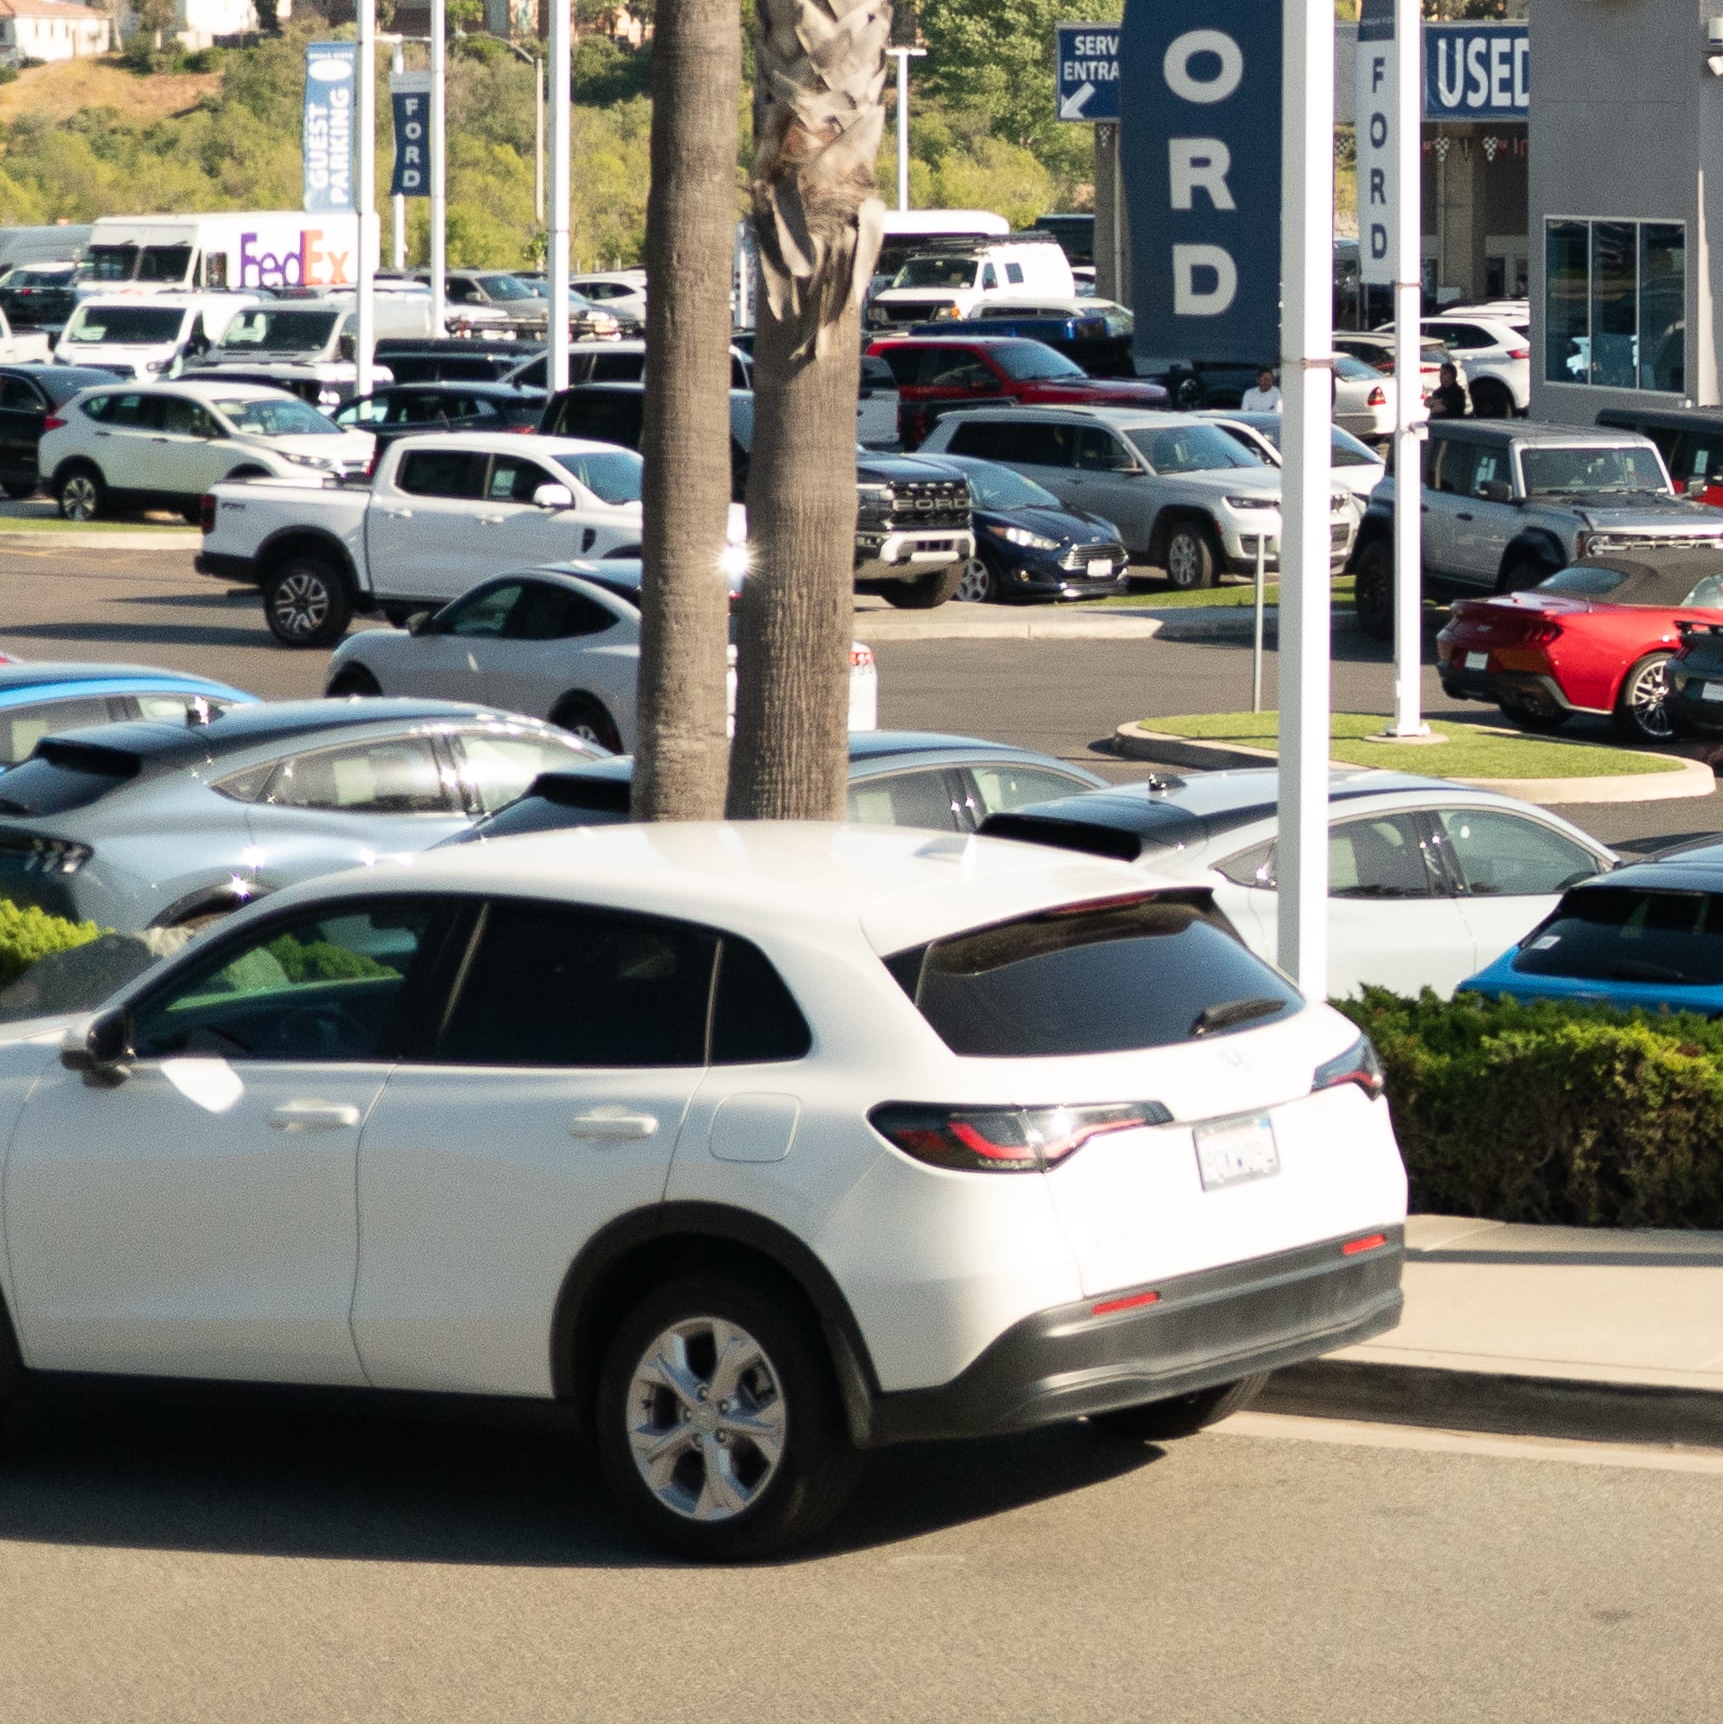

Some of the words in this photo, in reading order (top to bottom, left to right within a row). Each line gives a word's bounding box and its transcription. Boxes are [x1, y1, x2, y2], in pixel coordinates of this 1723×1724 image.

[1063, 61, 1120, 81] ENTRA
[1074, 36, 1119, 55] SERV
[309, 101, 328, 189] GUEST
[329, 88, 350, 204] PARKING
[403, 98, 421, 187] FORD
[1370, 57, 1388, 260] FORD
[240, 229, 349, 288] FedEx
